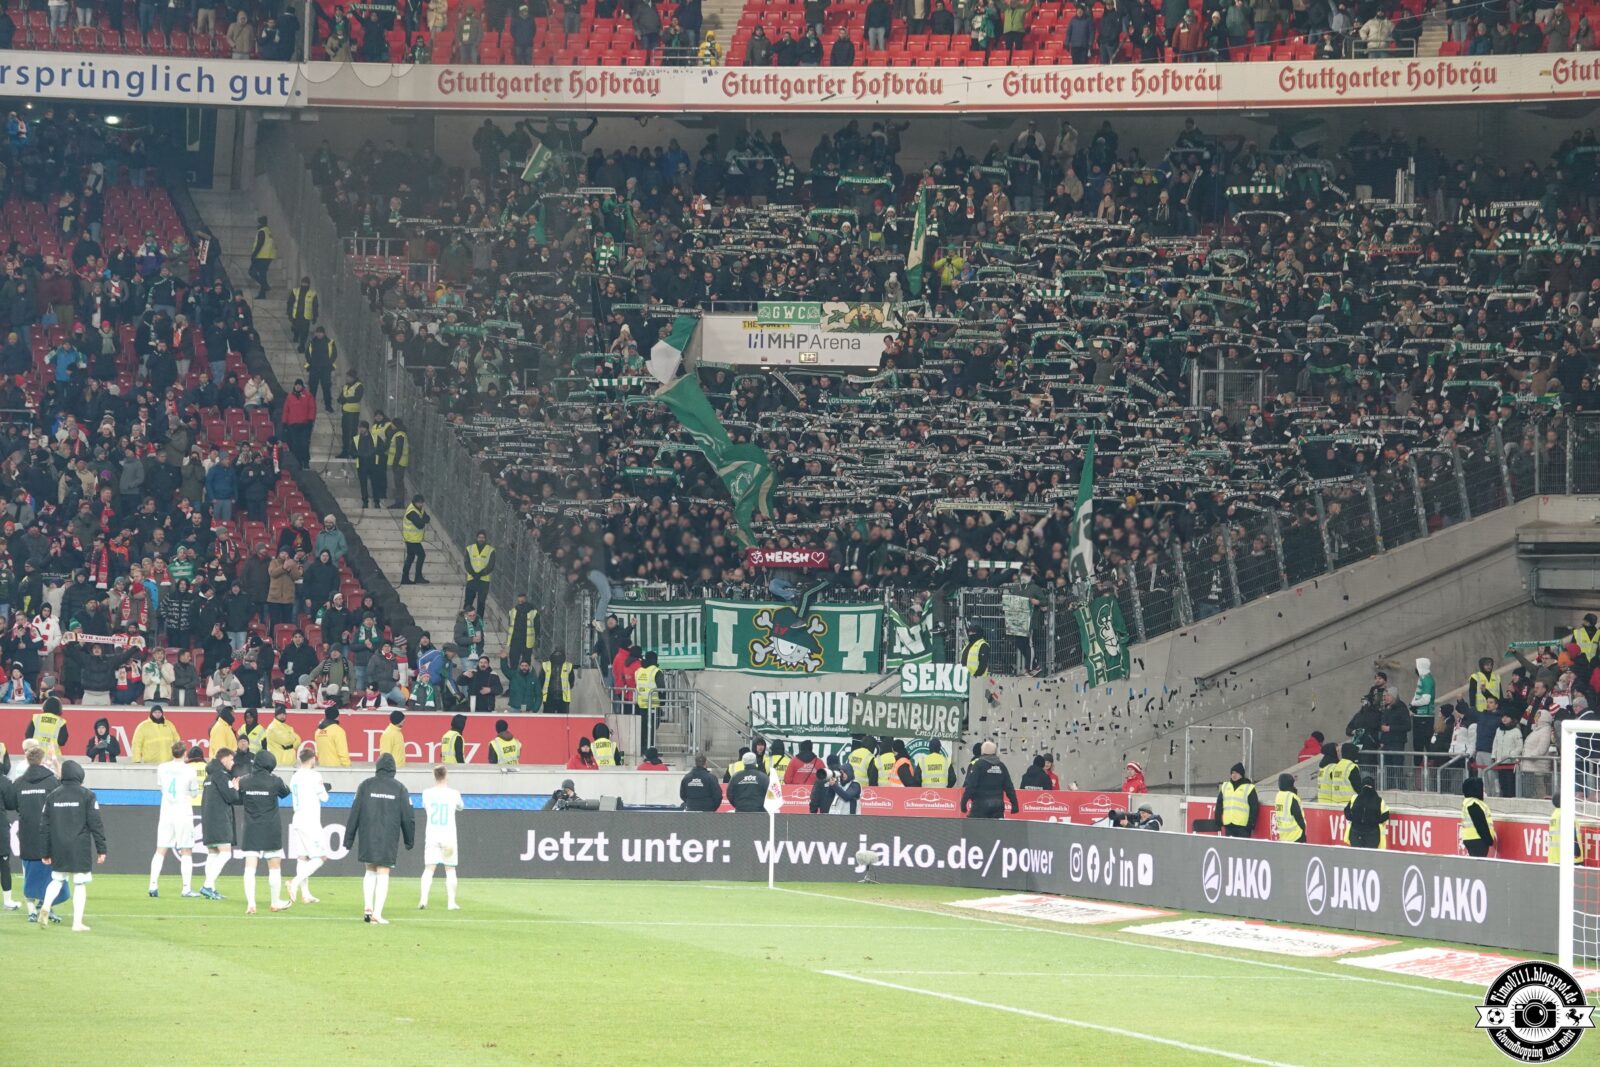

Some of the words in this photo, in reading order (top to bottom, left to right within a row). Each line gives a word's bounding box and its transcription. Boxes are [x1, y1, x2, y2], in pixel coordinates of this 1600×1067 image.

[229, 72, 302, 102] gut.
[438, 69, 563, 99] Stuttgarter
[568, 70, 661, 99] Hofbräu
[722, 72, 846, 101] Stuttgarter
[852, 70, 944, 99] Hofbräu
[1003, 70, 1125, 100] Stuttgarter
[1131, 67, 1222, 97] Hofbräu
[1279, 65, 1401, 95] Stuttgarter
[1407, 61, 1497, 91] Hofbräu
[773, 306, 806, 320] GWC
[768, 334, 808, 350] MHP
[809, 333, 861, 350] Arena
[765, 550, 810, 564] HERSH
[902, 662, 969, 693] SEKO
[751, 691, 849, 727] DETMOLD
[851, 699, 959, 733] PAPENBURG
[168, 777, 177, 799] 4
[430, 802, 449, 827] 20
[519, 829, 609, 862] Jetzt
[621, 831, 731, 864] unter:
[1226, 857, 1272, 900] JAKO
[1331, 866, 1381, 913] JAKO
[1430, 876, 1488, 924] JAKO
